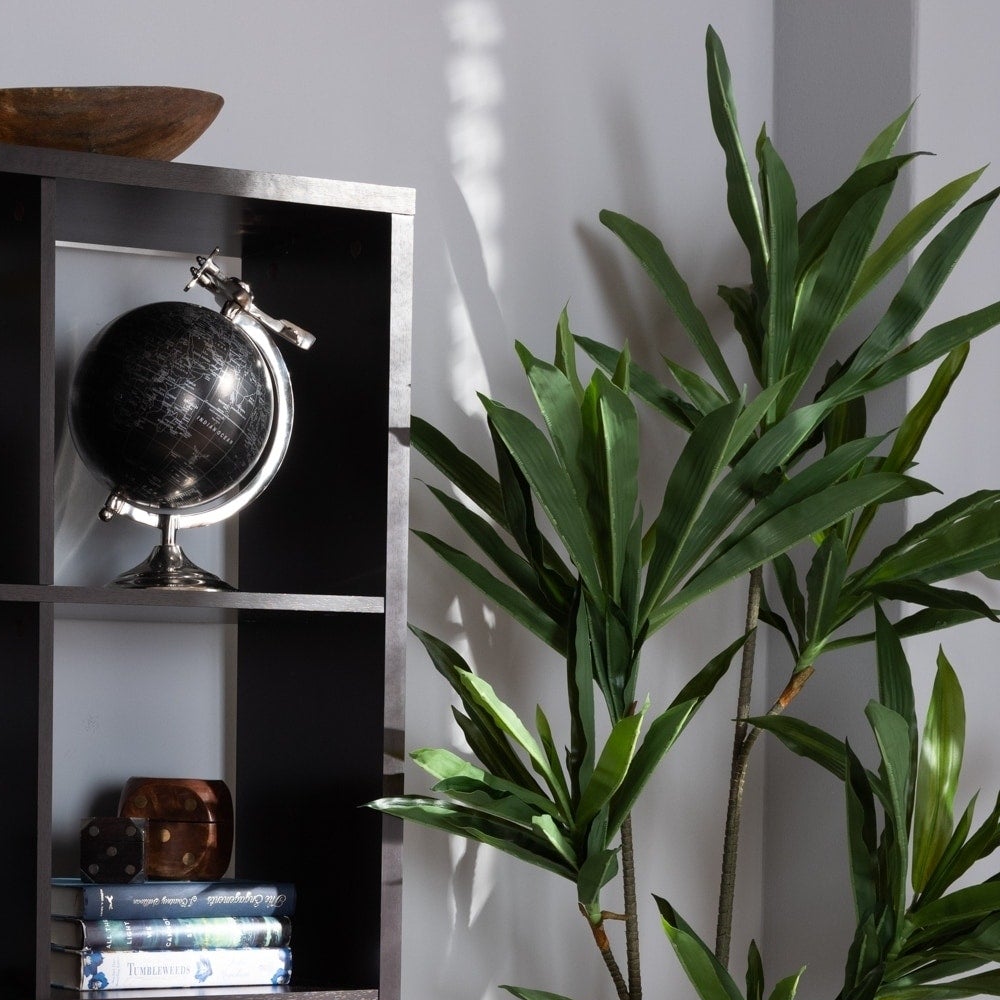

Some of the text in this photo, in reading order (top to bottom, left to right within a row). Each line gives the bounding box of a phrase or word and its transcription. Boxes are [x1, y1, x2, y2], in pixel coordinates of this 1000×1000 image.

[207, 891, 287, 908] The Engagements
[124, 921, 133, 945] LIGHT
[127, 961, 191, 976] TUMBLEWEEDS
